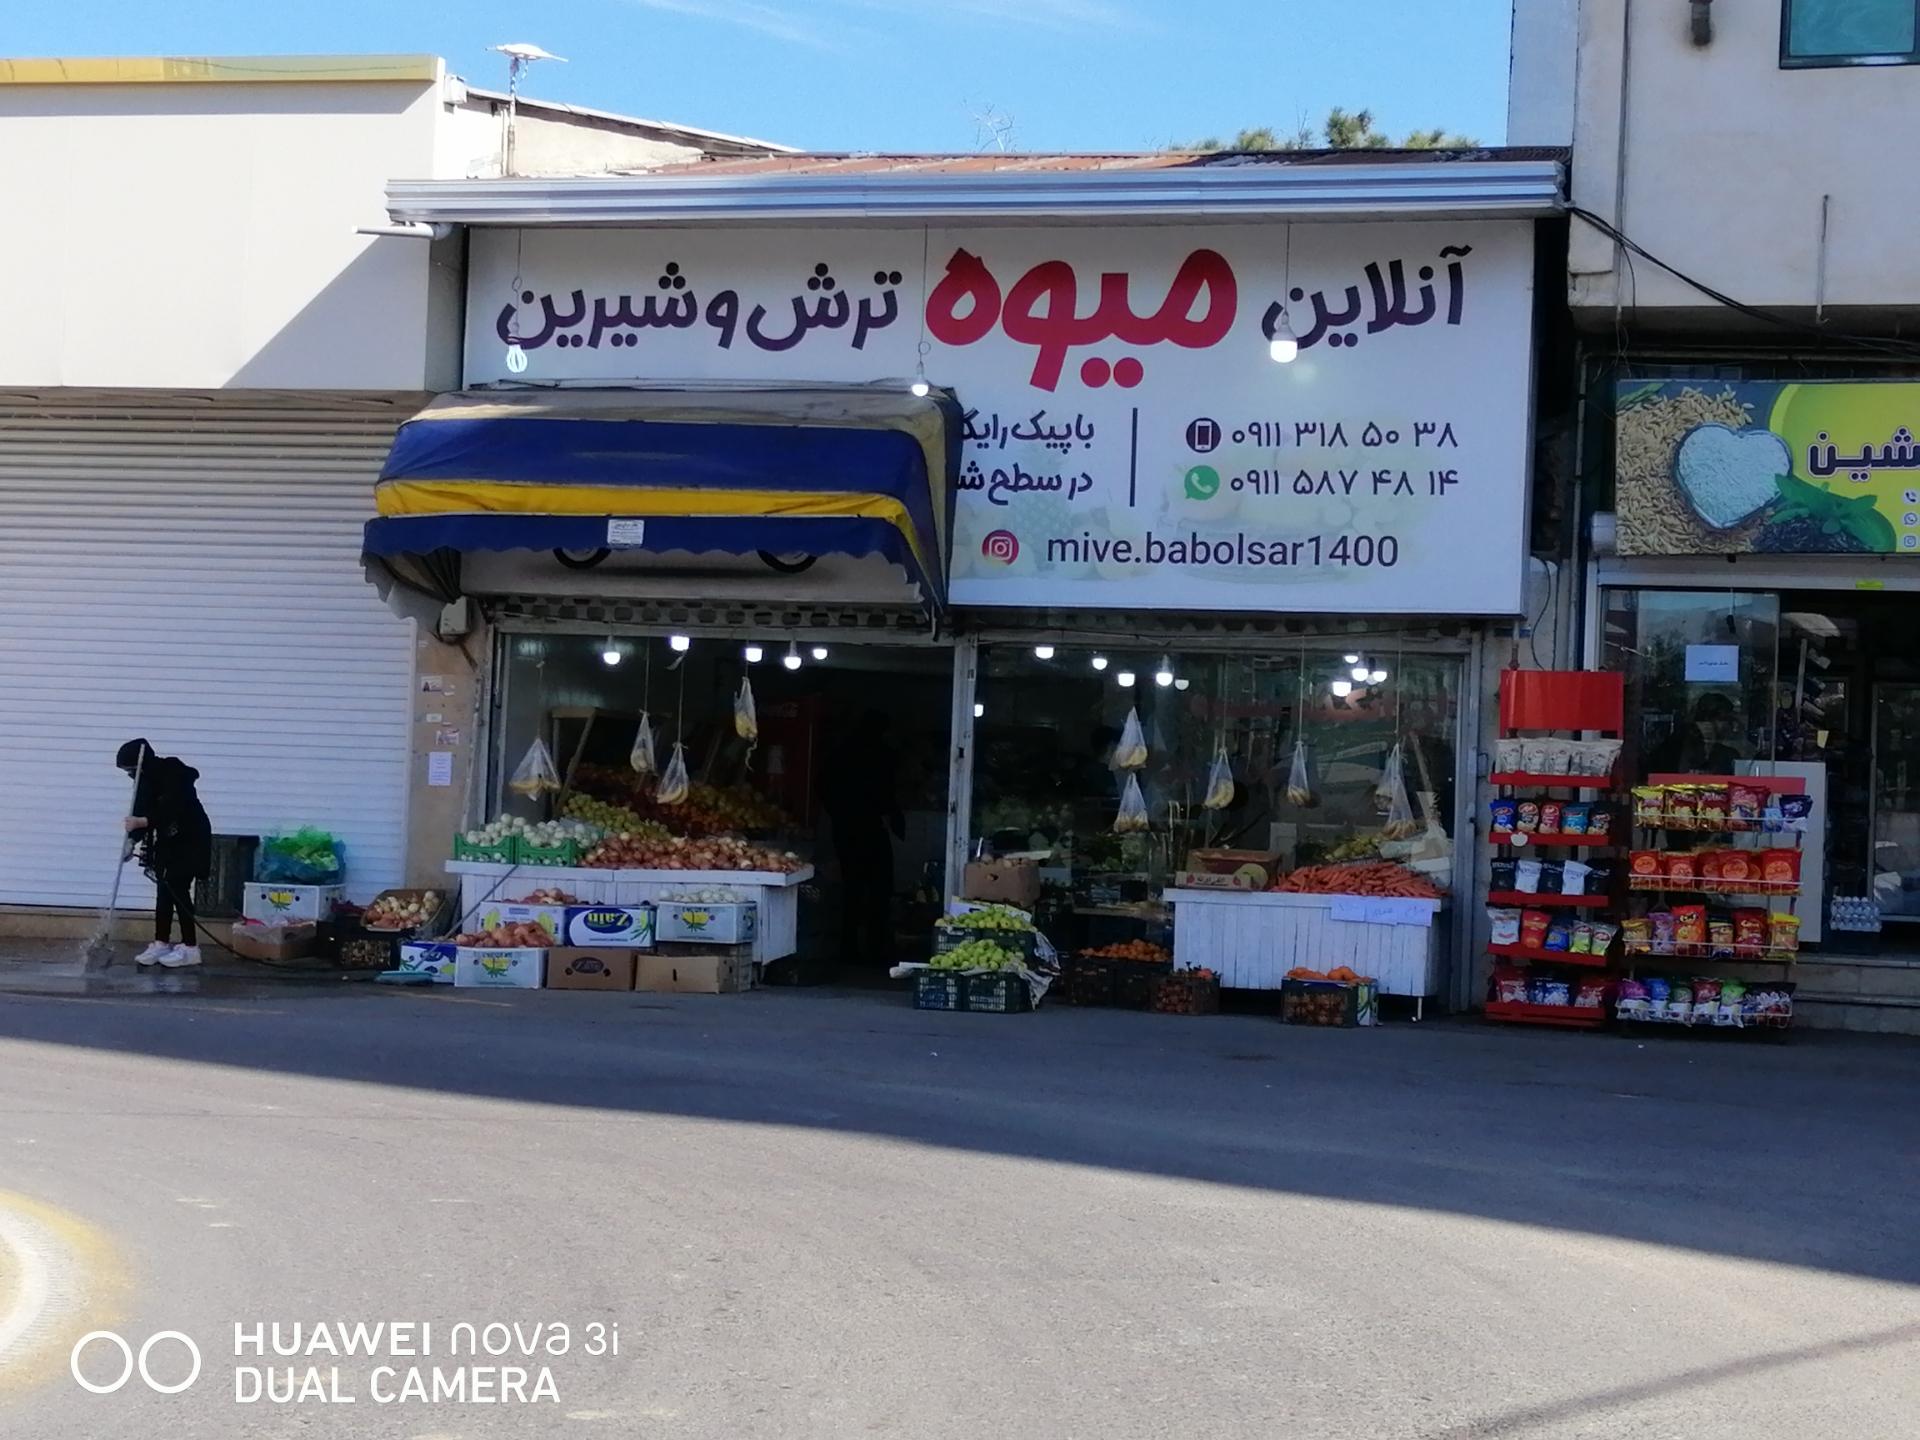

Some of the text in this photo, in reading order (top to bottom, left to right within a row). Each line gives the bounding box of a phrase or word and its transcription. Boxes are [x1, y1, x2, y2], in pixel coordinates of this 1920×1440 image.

[497, 244, 1472, 392] آنلاین میوه ترش و شیرین
[1232, 421, 1458, 448] ۰۹۱۱ ۳۱۸ ۵۰ ۳۸
[988, 462, 1062, 506] سطح
[1068, 472, 1093, 501] در
[1230, 469, 1459, 496] ۰۹۱۱ ۵۸۷ ۴۸ ۱۴
[1047, 531, 1399, 568] mive.babolsar1400
